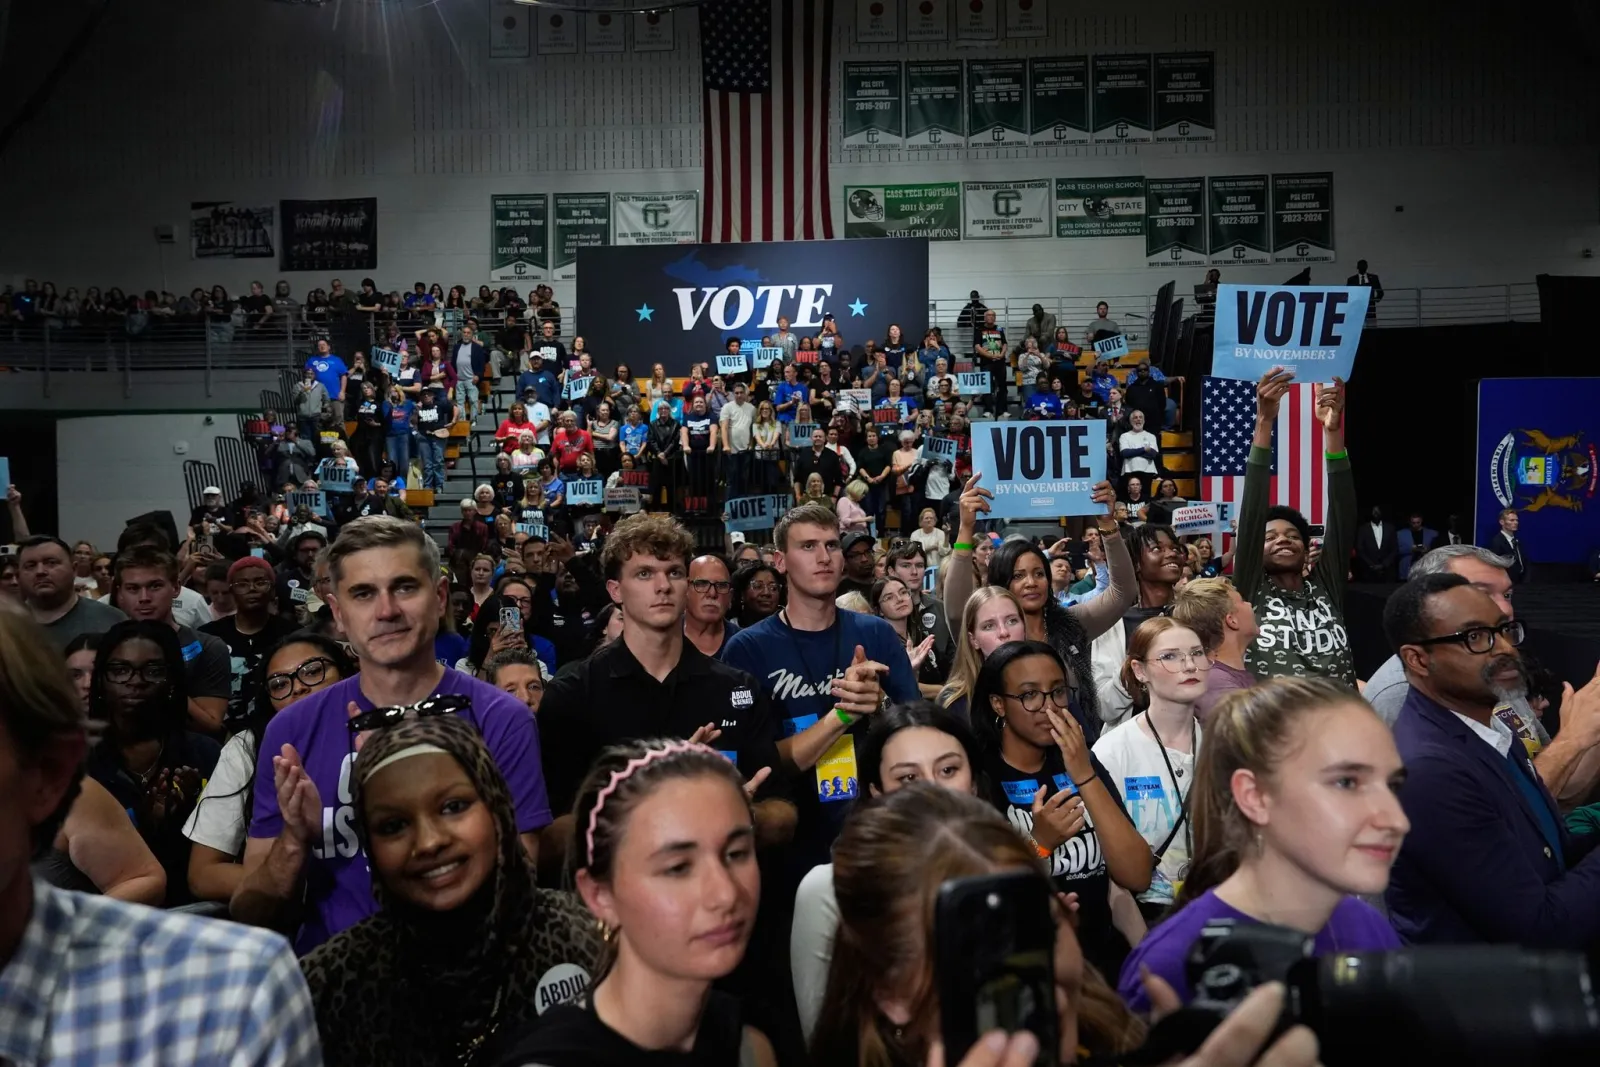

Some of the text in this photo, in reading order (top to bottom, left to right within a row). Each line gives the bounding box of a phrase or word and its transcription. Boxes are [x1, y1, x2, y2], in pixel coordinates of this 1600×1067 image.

[886, 187, 958, 198] CASS TECH FOOTBALL
[899, 204, 917, 212] 2011
[926, 203, 944, 211] 2012
[1058, 204, 1079, 212] CITY
[1115, 202, 1143, 210] STATE
[909, 216, 929, 225] Div.
[1219, 216, 1259, 225] 2022-2023
[1282, 213, 1323, 222] 2023-2024
[886, 228, 960, 238] STATE CHAMPIONS
[672, 283, 834, 330] VOTE
[1237, 290, 1349, 347] VOTE
[1098, 337, 1122, 353] VOTE
[375, 348, 398, 366] VOTE
[756, 348, 779, 360] VOTE
[796, 351, 818, 363] VOTE
[1234, 347, 1336, 360] BY NOVEMBER 3
[720, 356, 742, 367] VOTE
[962, 373, 986, 386] VOTE
[873, 409, 897, 422] VOTE
[928, 437, 953, 454] VOTE
[990, 425, 1091, 481] VOTE
[323, 467, 350, 483] VOTE
[623, 471, 649, 485] VOTE
[571, 481, 598, 495] VOTE
[995, 481, 1089, 495] BY NOVEMBER 3
[292, 493, 321, 507] VOTE
[729, 500, 767, 519] VOTE
[1177, 507, 1209, 516] MOVING
[1175, 513, 1213, 522] MICHIGAN
[1175, 519, 1214, 529] FORWARD
[731, 690, 753, 699] ABDUL
[540, 973, 589, 1008] ABDUL
